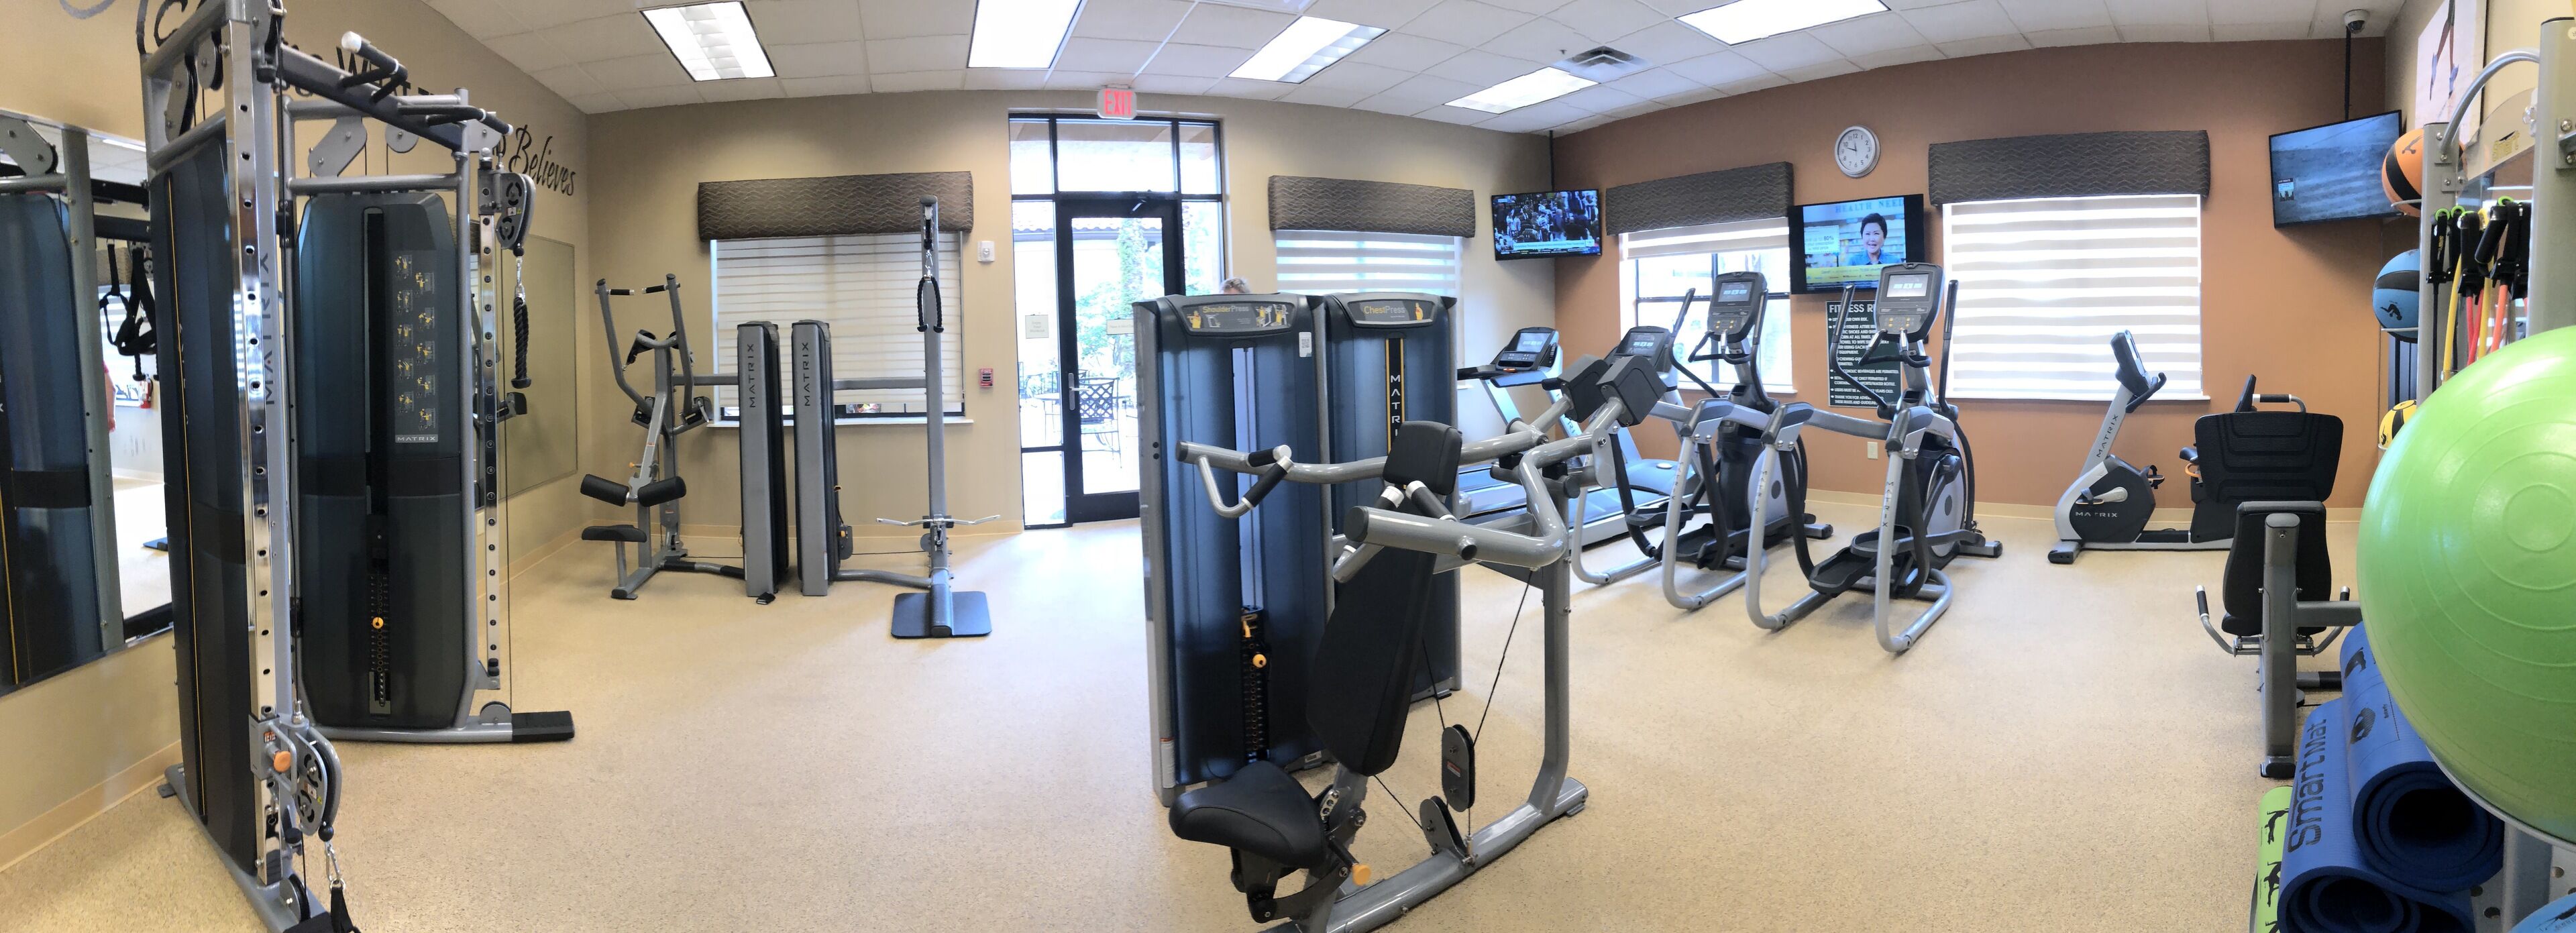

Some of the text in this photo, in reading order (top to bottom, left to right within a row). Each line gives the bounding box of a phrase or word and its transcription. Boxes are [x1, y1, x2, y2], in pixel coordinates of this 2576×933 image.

[1104, 89, 1134, 118] EXIT
[508, 125, 576, 197] Believes
[260, 253, 275, 405] MATRIX
[1202, 305, 1250, 313] ShoulderPress
[1364, 305, 1406, 315] ChestPress
[1829, 304, 1865, 313] FITESS
[747, 343, 756, 408] MATRIX
[802, 342, 811, 406] MATRIX
[1391, 374, 1401, 437] MATRI
[2096, 415, 2118, 457] MATRIX
[1882, 482, 1894, 527] MATRIX
